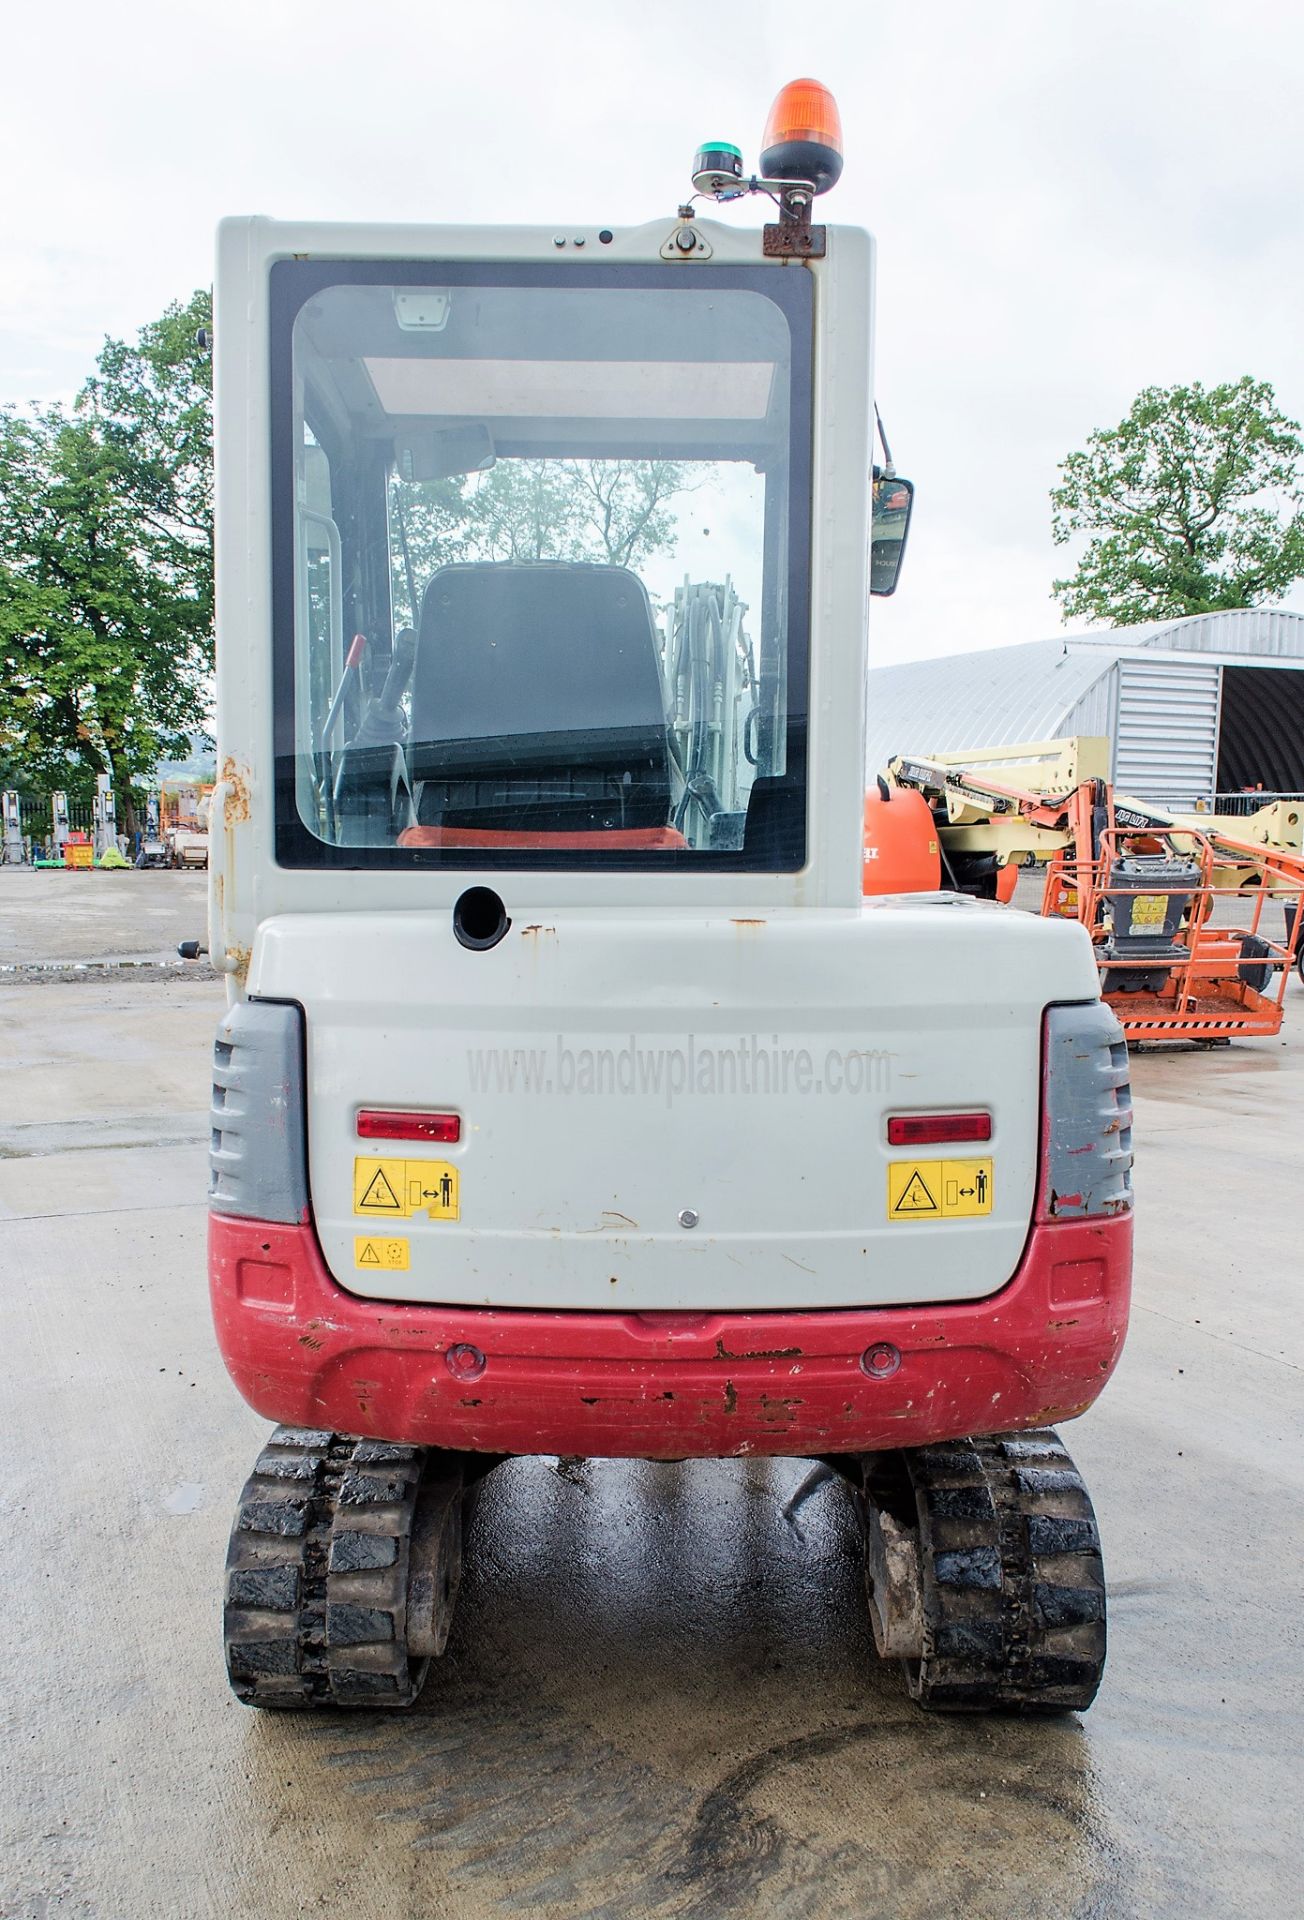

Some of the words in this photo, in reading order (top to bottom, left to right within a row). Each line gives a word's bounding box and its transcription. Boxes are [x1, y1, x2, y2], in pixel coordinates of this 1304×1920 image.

[1115, 809, 1131, 822] JLG
[1129, 814, 1149, 828] LIFT
[467, 1034, 890, 1109] www.bandwplanthire.com
